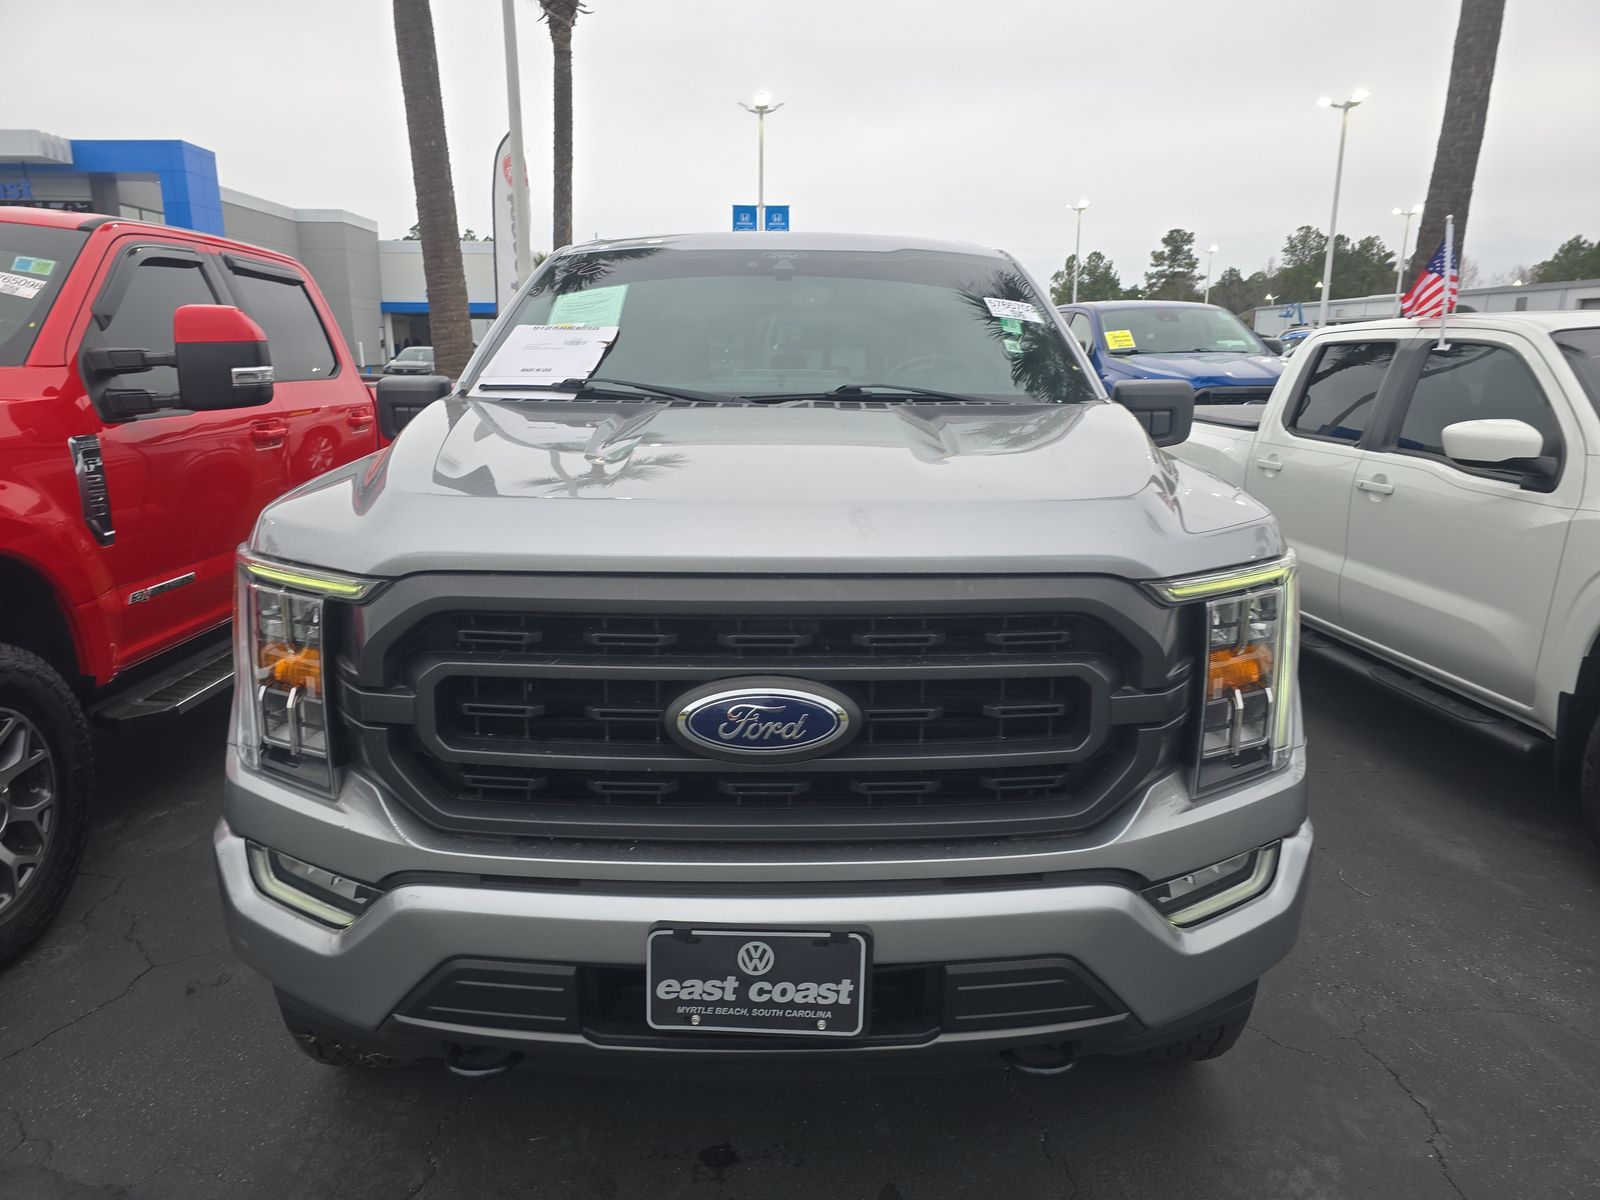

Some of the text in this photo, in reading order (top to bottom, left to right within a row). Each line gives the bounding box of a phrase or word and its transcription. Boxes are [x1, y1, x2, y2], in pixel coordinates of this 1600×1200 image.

[718, 704, 809, 740] Ford
[656, 976, 854, 1005] east coast
[676, 1006, 832, 1019] MYRTLE BEACH, SOUTH CAROLINA
